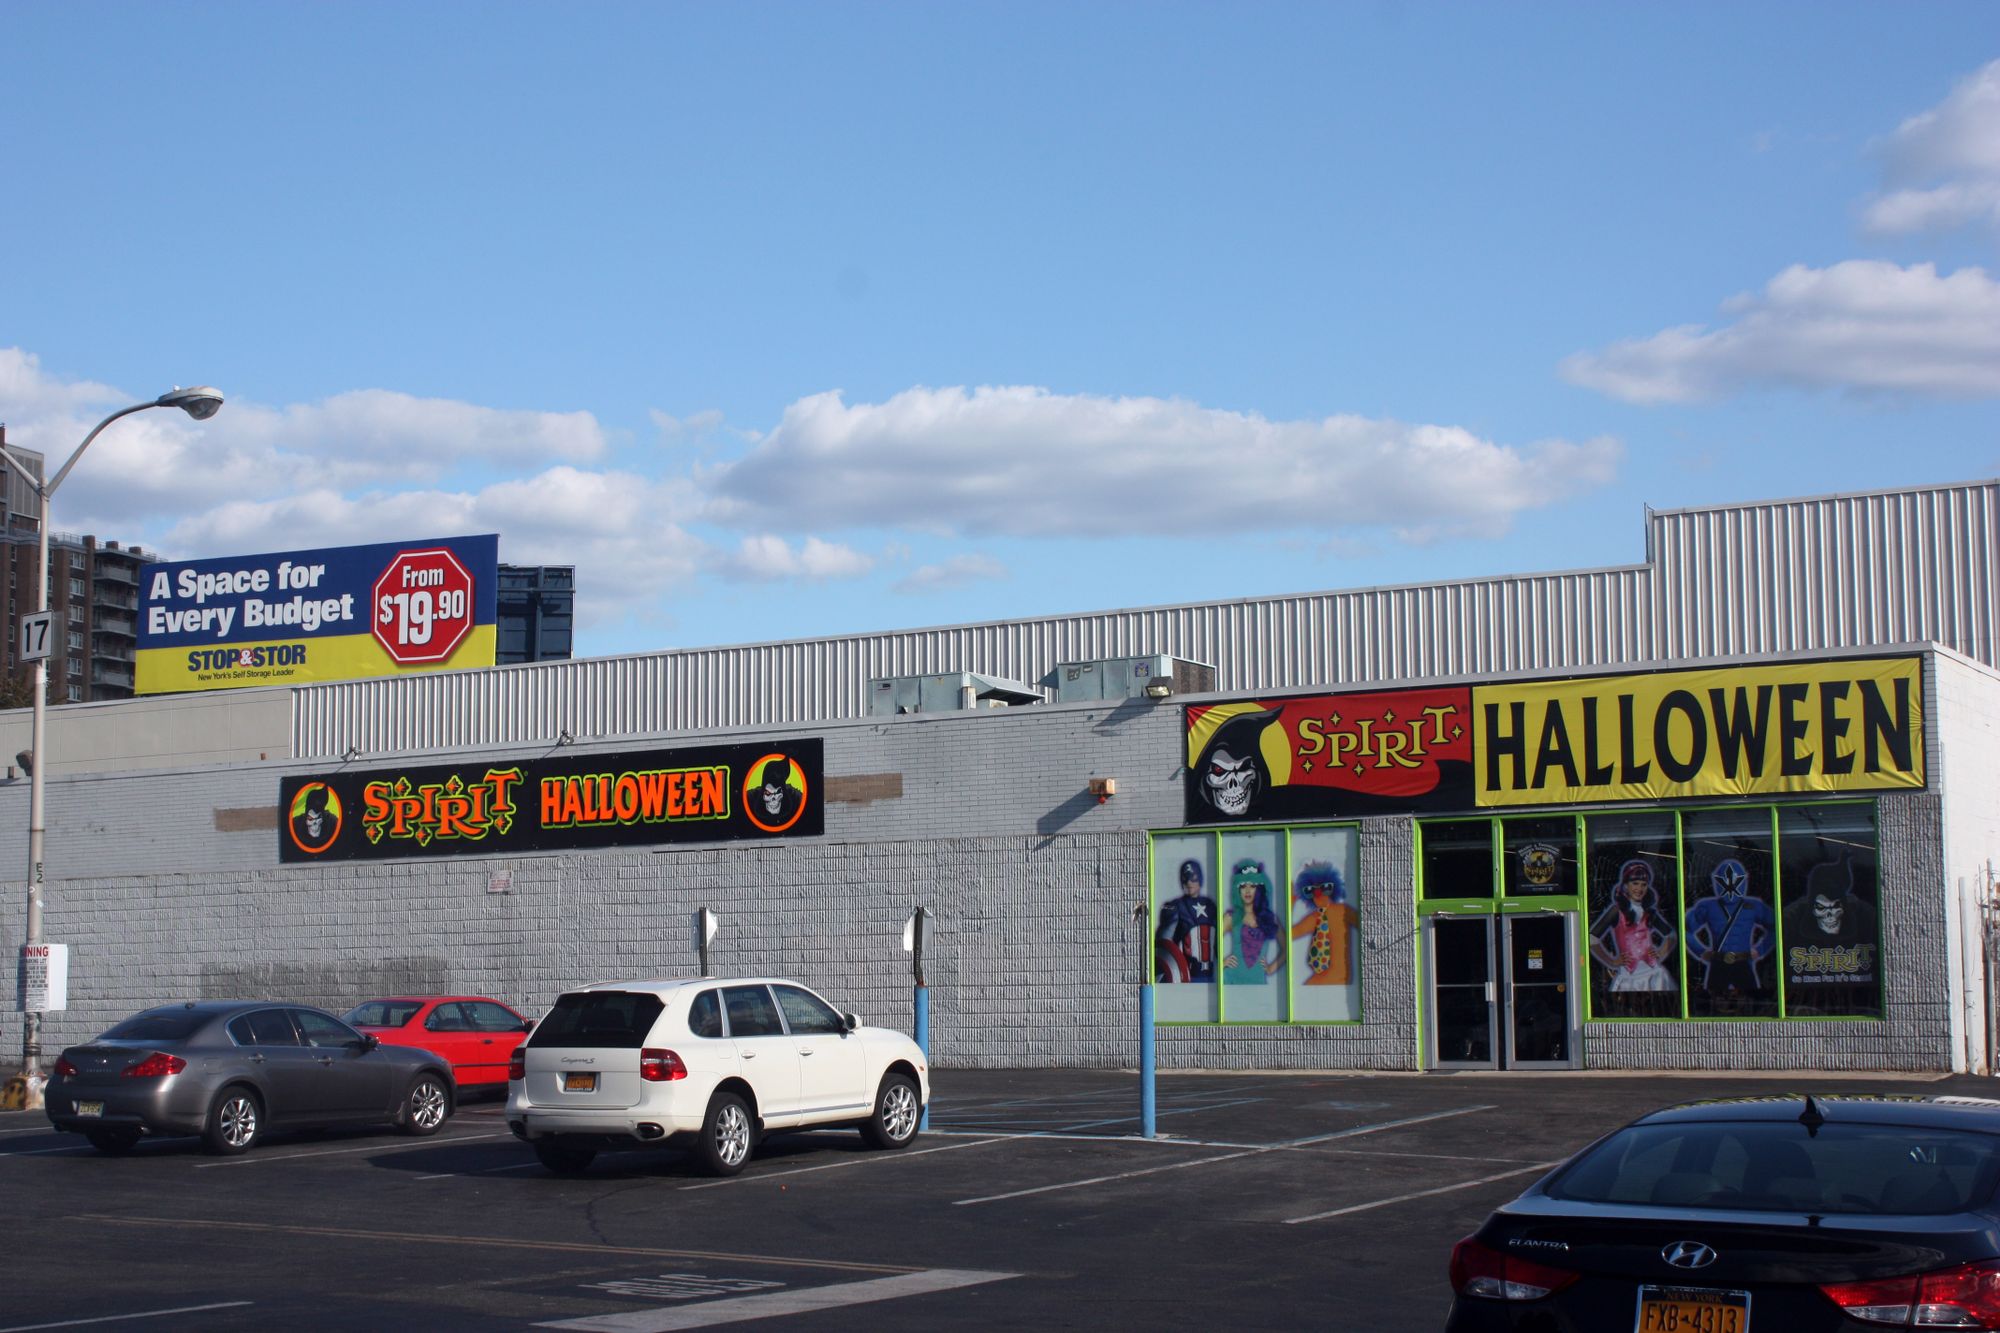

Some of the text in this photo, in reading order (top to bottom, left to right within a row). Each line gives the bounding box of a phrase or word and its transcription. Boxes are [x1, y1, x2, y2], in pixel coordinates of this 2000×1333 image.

[150, 561, 325, 604] A Space for
[402, 565, 444, 588] From
[148, 593, 354, 638] Every Budget
[380, 589, 465, 645] $19.90
[25, 619, 49, 653] 17
[187, 644, 306, 672] STOP&STOR
[212, 672, 232, 680] York's
[246, 669, 271, 678] Storage
[272, 668, 295, 676] Leader
[1297, 677, 1913, 791] SPIRIT HALLOWEEN
[362, 765, 731, 841] SPIRIT HALLOWEEN
[1790, 944, 1876, 973] SPIRIT
[1508, 1237, 1569, 1251] ELANTRA
[1667, 1292, 1723, 1303] NEW YORK
